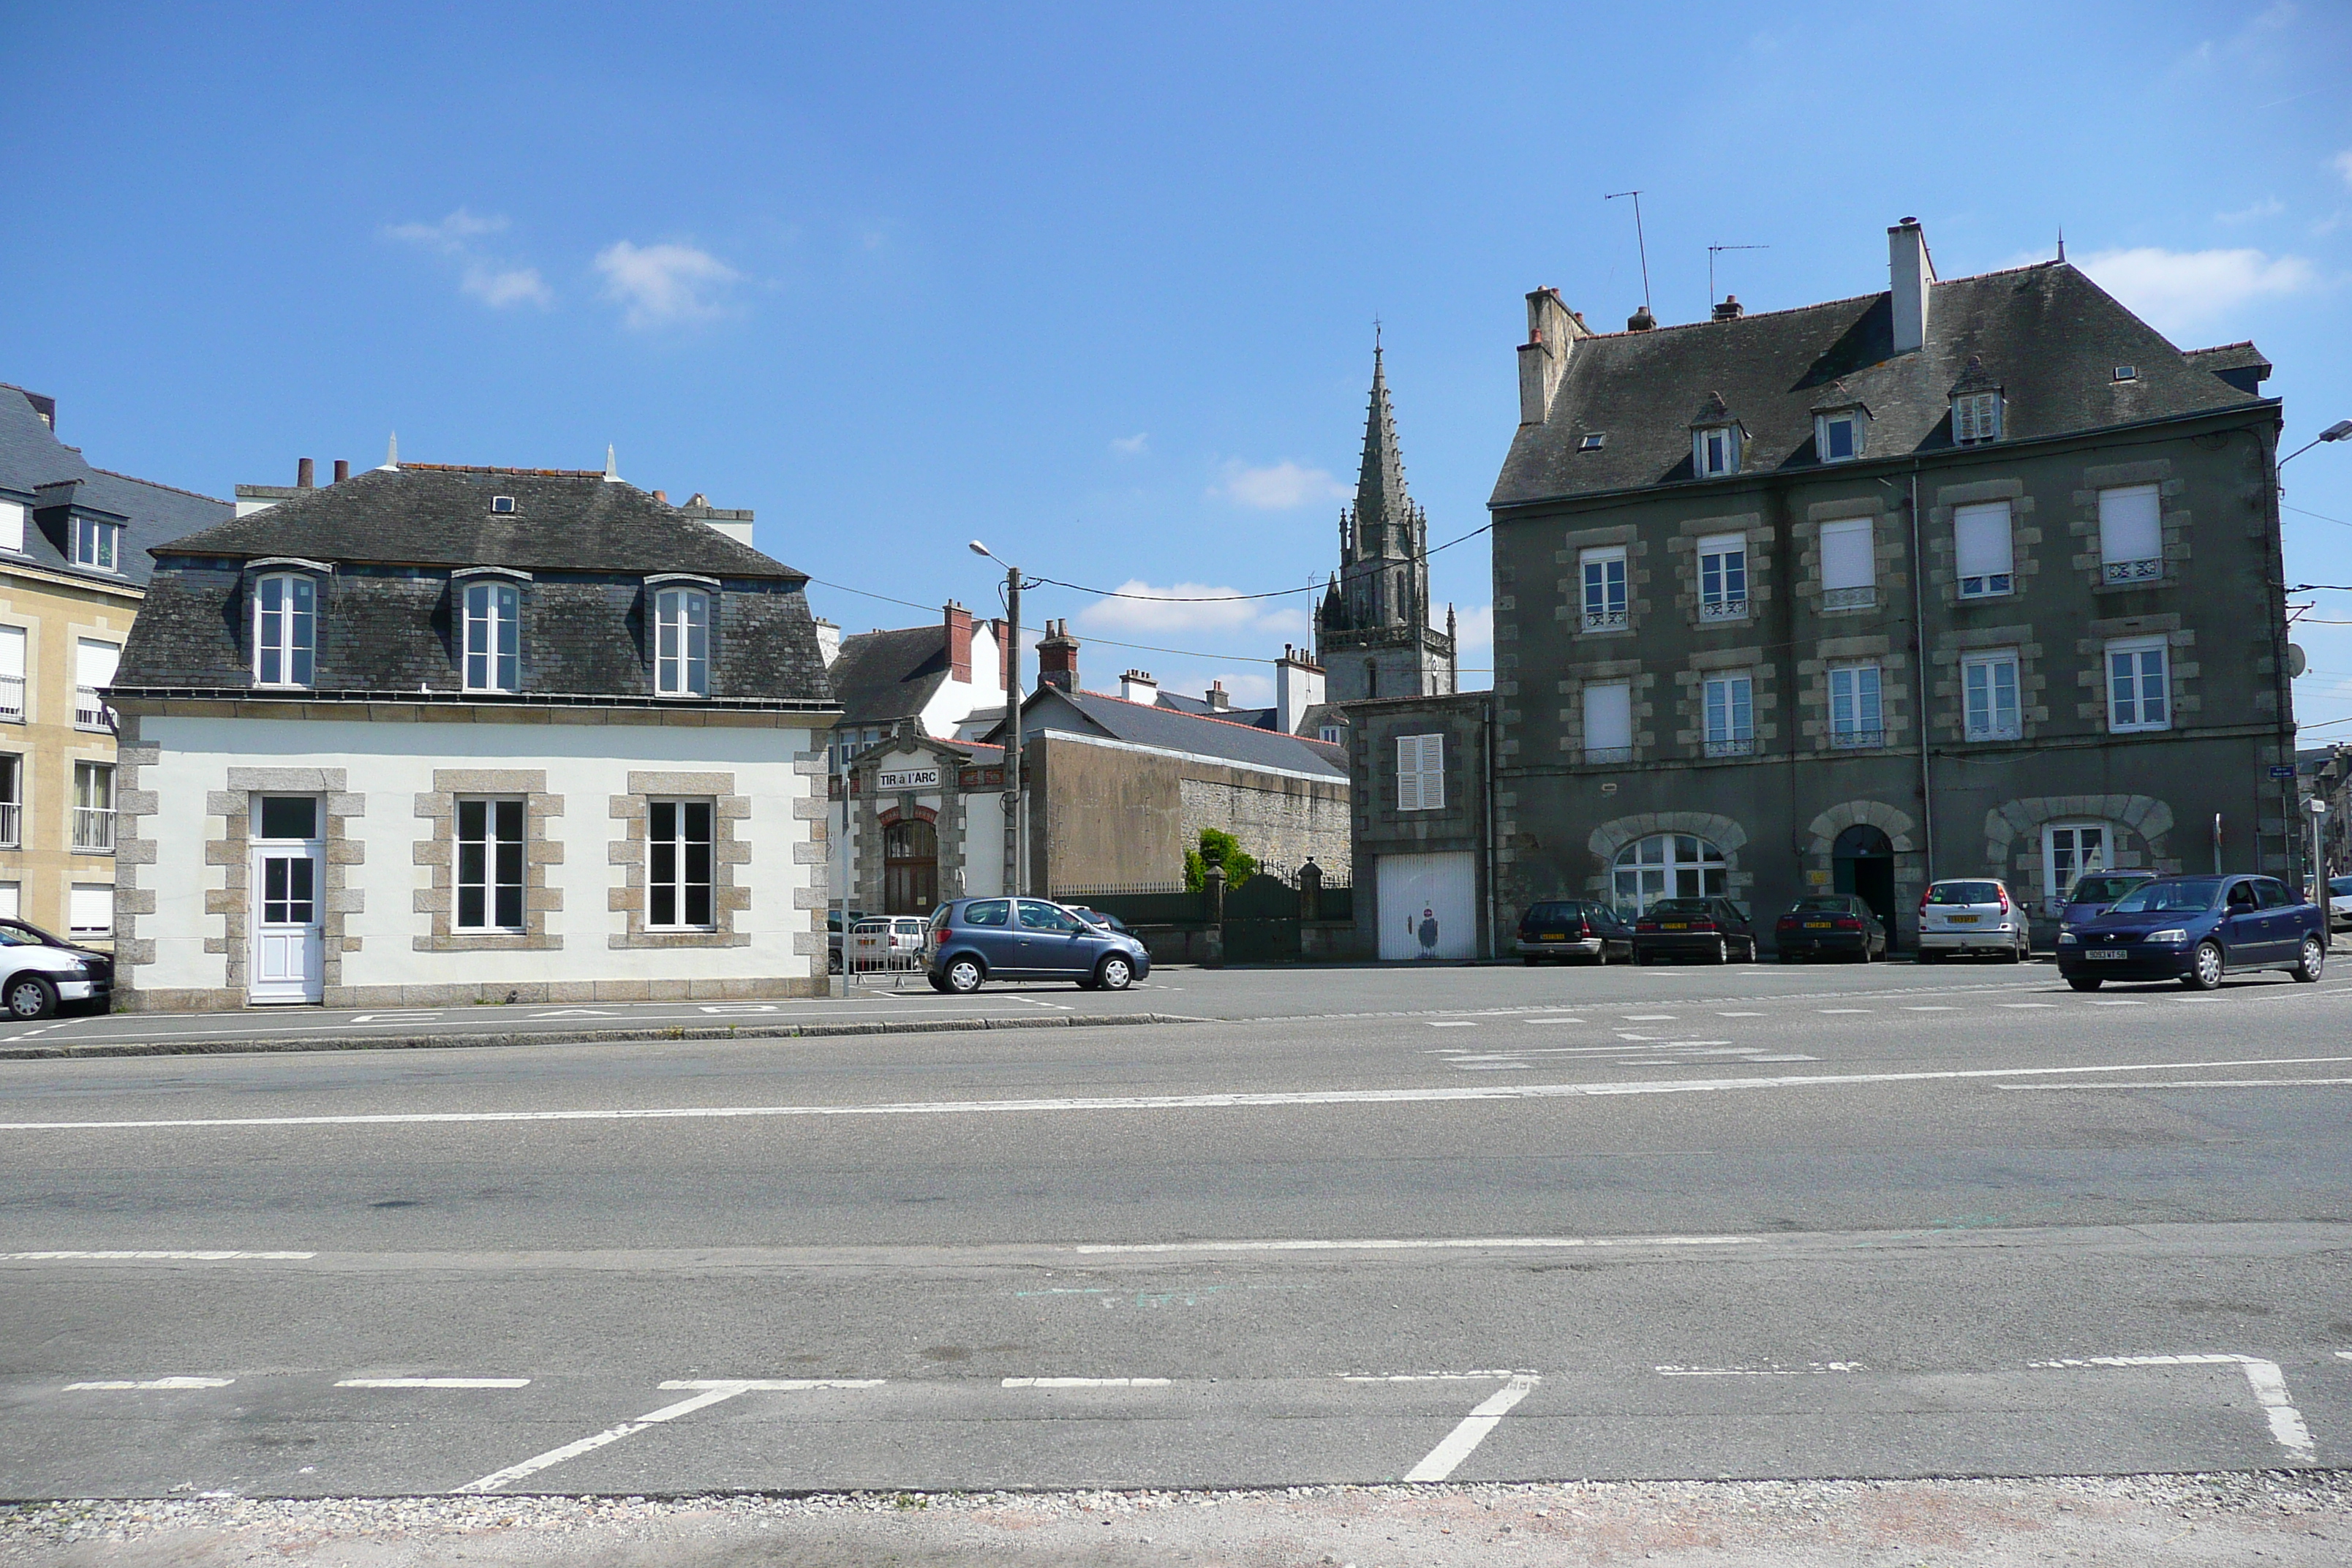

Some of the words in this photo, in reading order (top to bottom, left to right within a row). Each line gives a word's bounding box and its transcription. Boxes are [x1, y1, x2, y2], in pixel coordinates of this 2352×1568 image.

[880, 774, 897, 785] TIR
[899, 774, 905, 784] à
[908, 772, 936, 783] l'ARC
